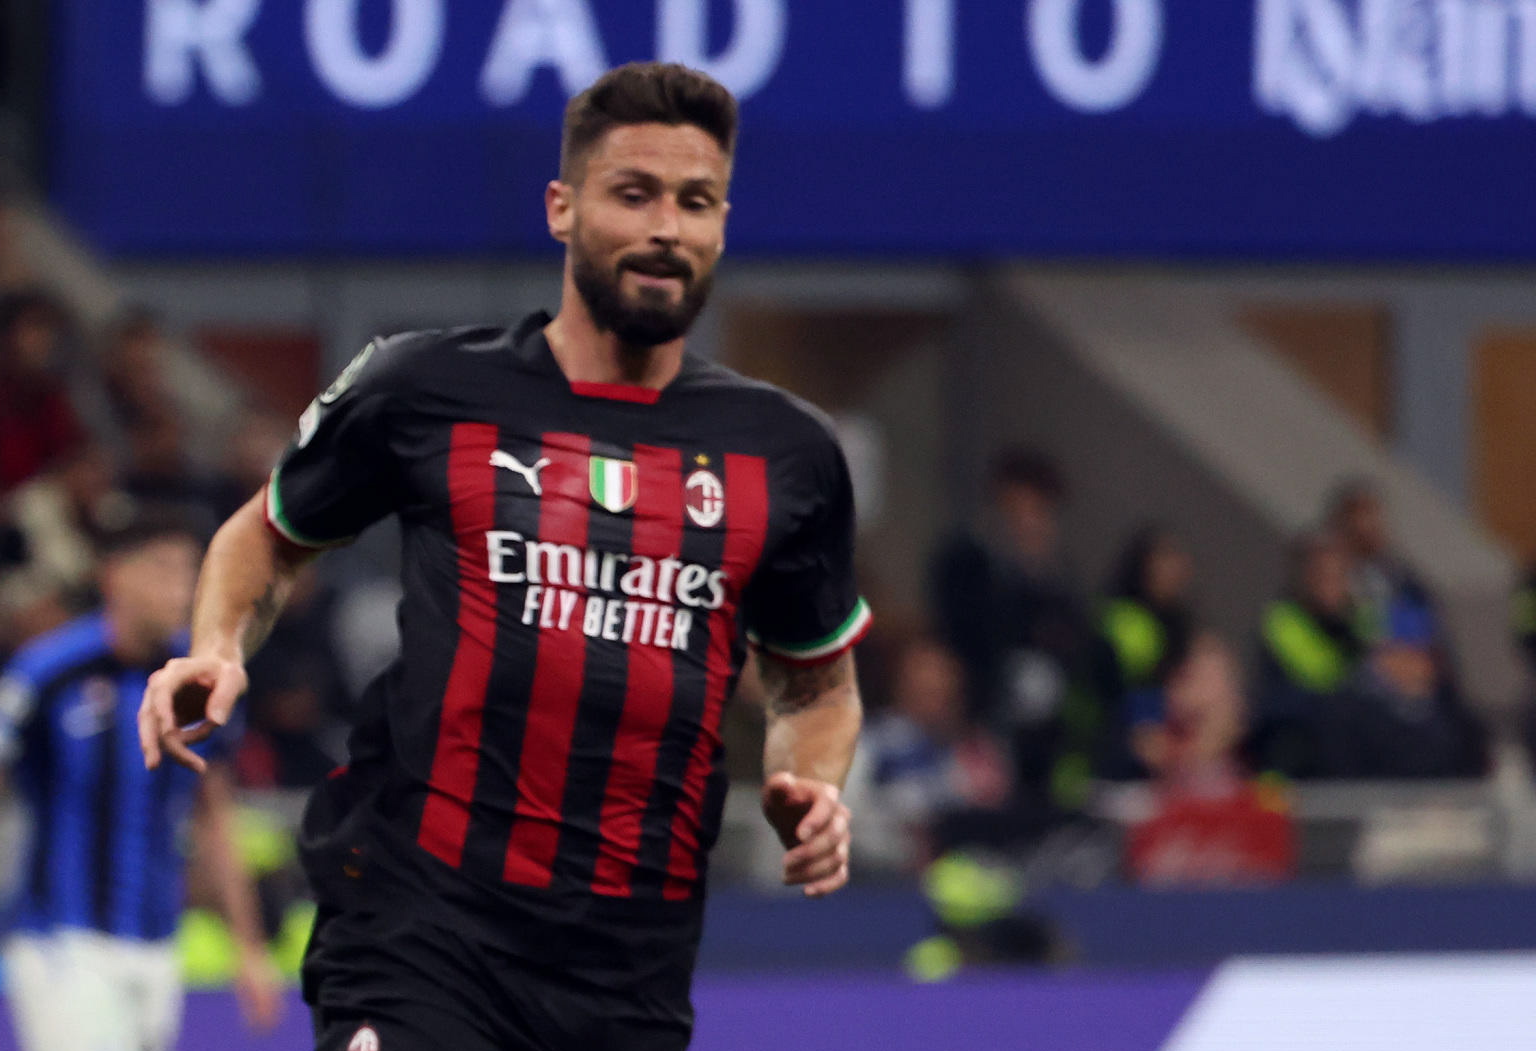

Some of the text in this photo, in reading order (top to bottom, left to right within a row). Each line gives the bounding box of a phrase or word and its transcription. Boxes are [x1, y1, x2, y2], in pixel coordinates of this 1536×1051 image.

[486, 530, 728, 610] Emirates
[521, 585, 693, 650] FLY BETTER
